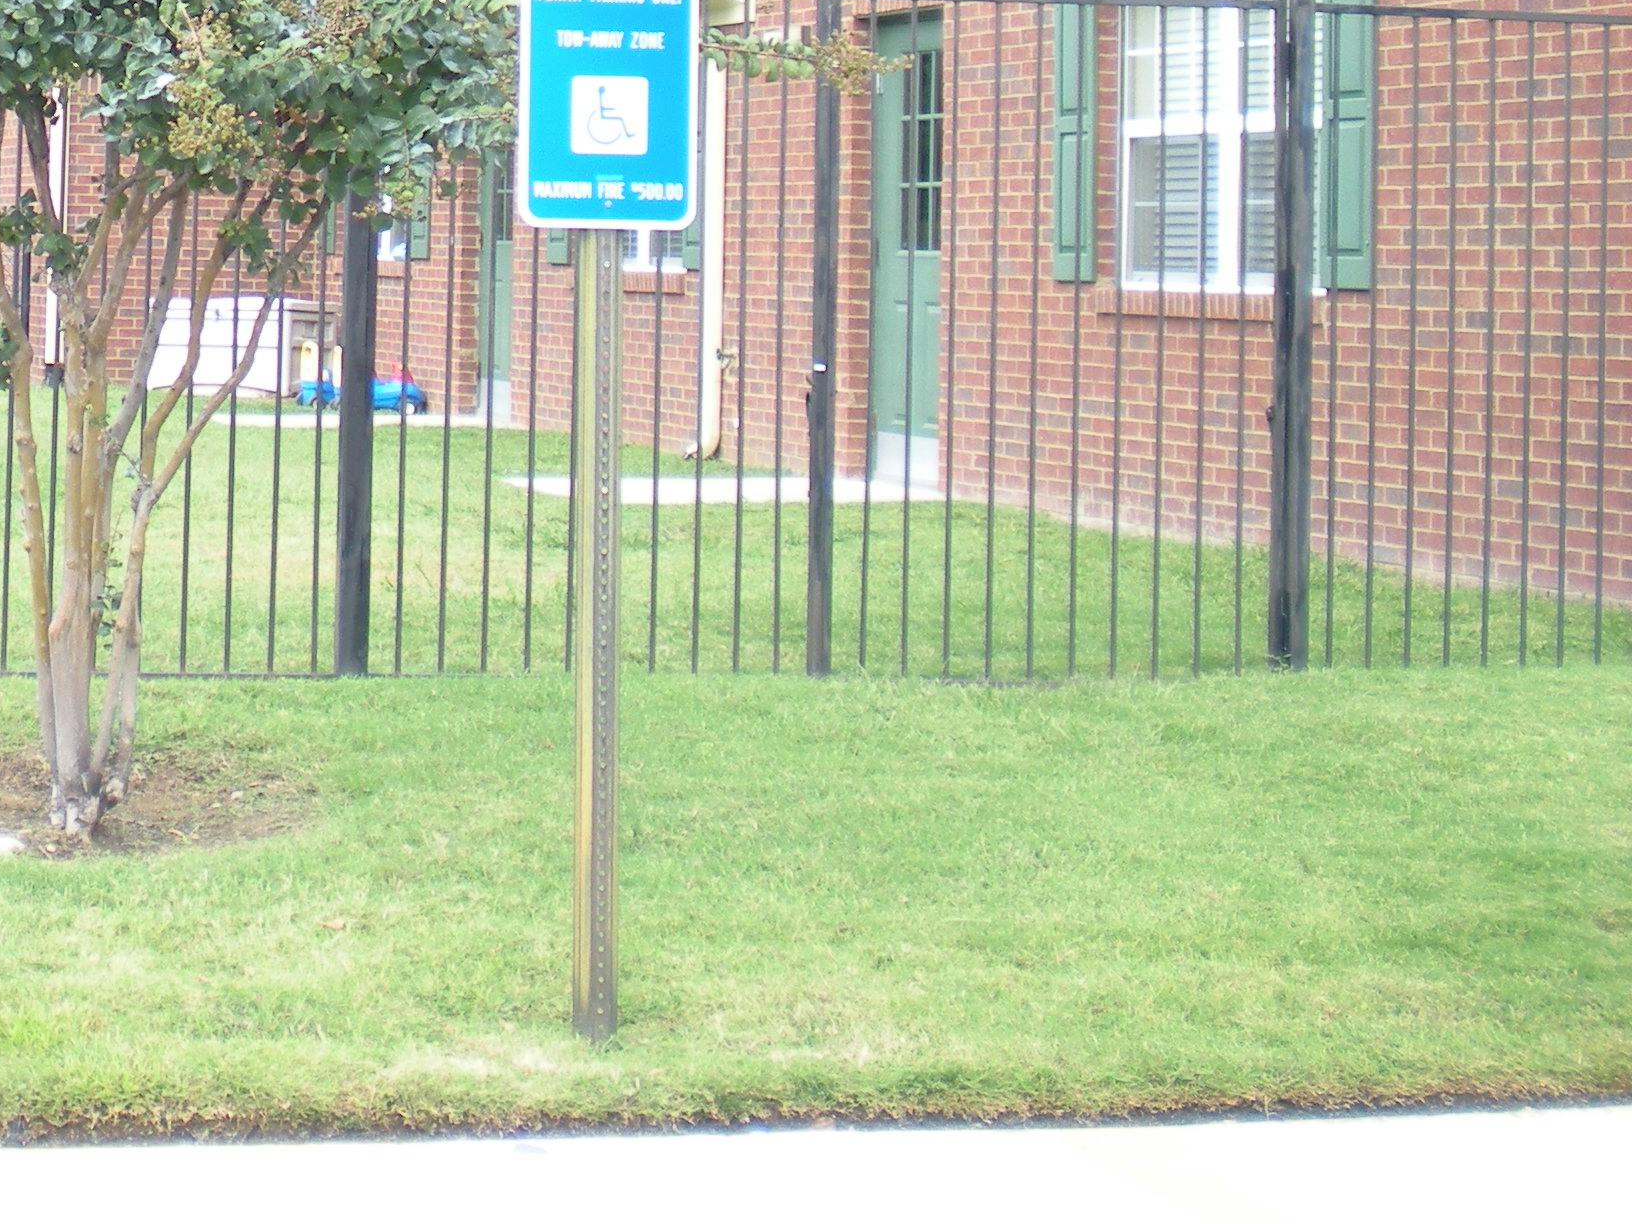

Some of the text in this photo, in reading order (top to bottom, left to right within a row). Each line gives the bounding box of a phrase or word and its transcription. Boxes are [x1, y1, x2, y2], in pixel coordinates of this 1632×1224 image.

[556, 29, 665, 50] TOW-AWAY ZONE
[533, 181, 592, 199] MAXIMUM
[597, 181, 625, 200] FINE
